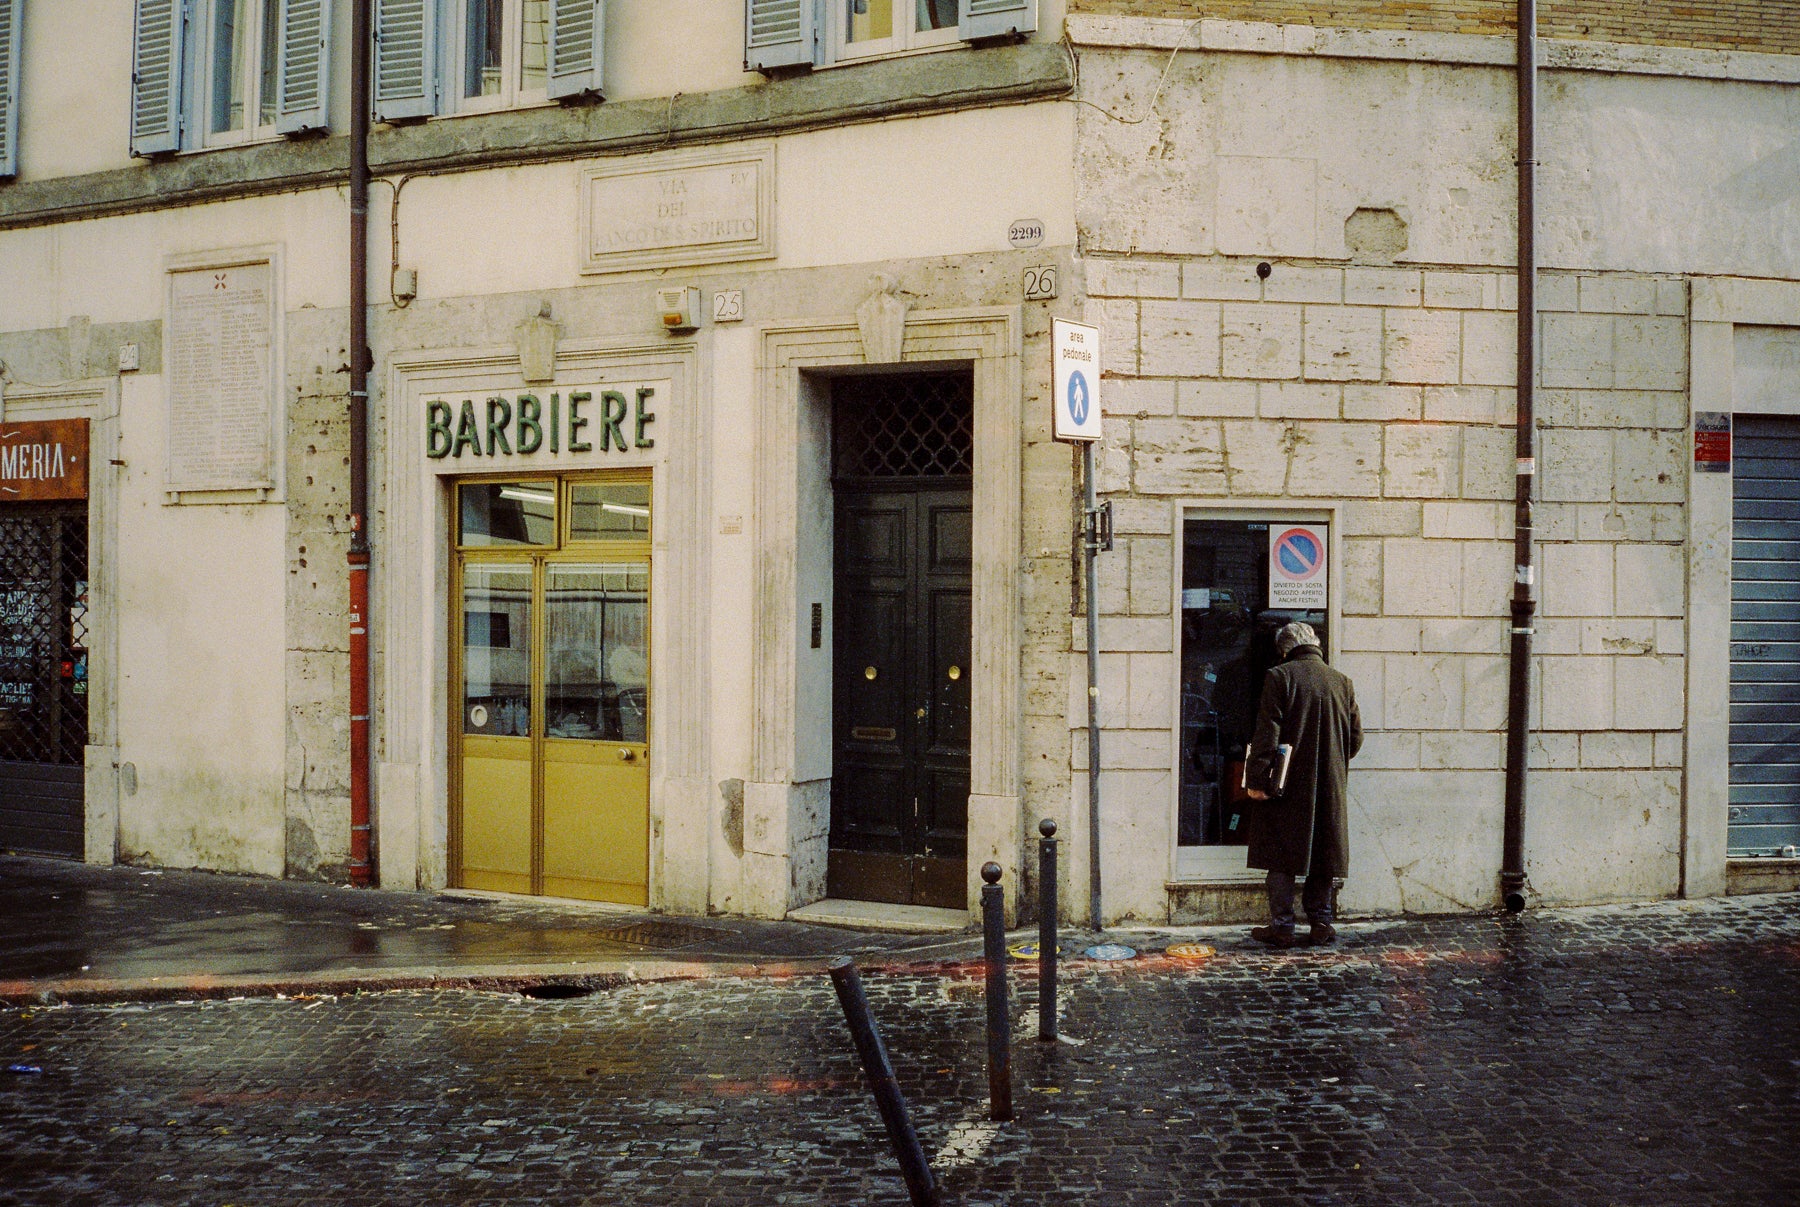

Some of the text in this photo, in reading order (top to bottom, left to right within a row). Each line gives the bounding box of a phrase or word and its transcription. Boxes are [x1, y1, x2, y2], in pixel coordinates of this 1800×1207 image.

[659, 179, 688, 196] VIA
[658, 201, 688, 218] DEL
[1011, 226, 1042, 240] 2299
[1024, 268, 1055, 295] 26
[715, 293, 741, 317] 25
[1069, 331, 1085, 344] area
[1062, 347, 1093, 363] pedonale
[426, 387, 656, 459] BARBIERE
[1, 442, 66, 481] MERIA
